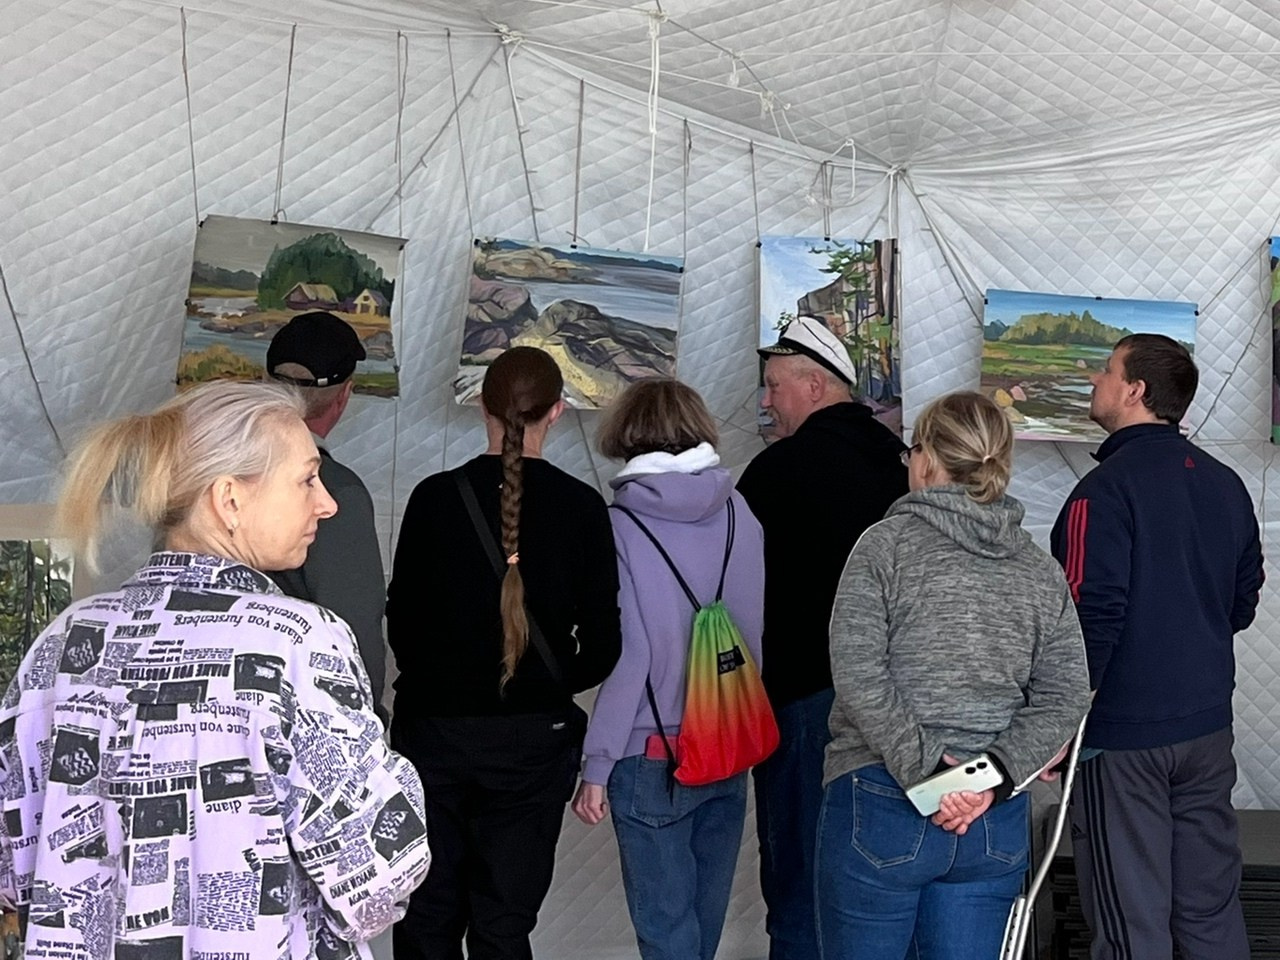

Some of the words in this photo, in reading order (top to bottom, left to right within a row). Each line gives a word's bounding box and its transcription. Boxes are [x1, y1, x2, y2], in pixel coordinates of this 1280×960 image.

[173, 614, 244, 628] furstenberg
[245, 601, 312, 635] furstenberg
[247, 614, 270, 628] von
[273, 622, 304, 646] diane
[172, 664, 195, 680] VON
[195, 663, 231, 678] DIANE
[235, 692, 265, 706] diane
[200, 722, 224, 733] von
[146, 779, 168, 795] VON
[205, 799, 242, 814] diane
[348, 889, 372, 907] AGAIN
